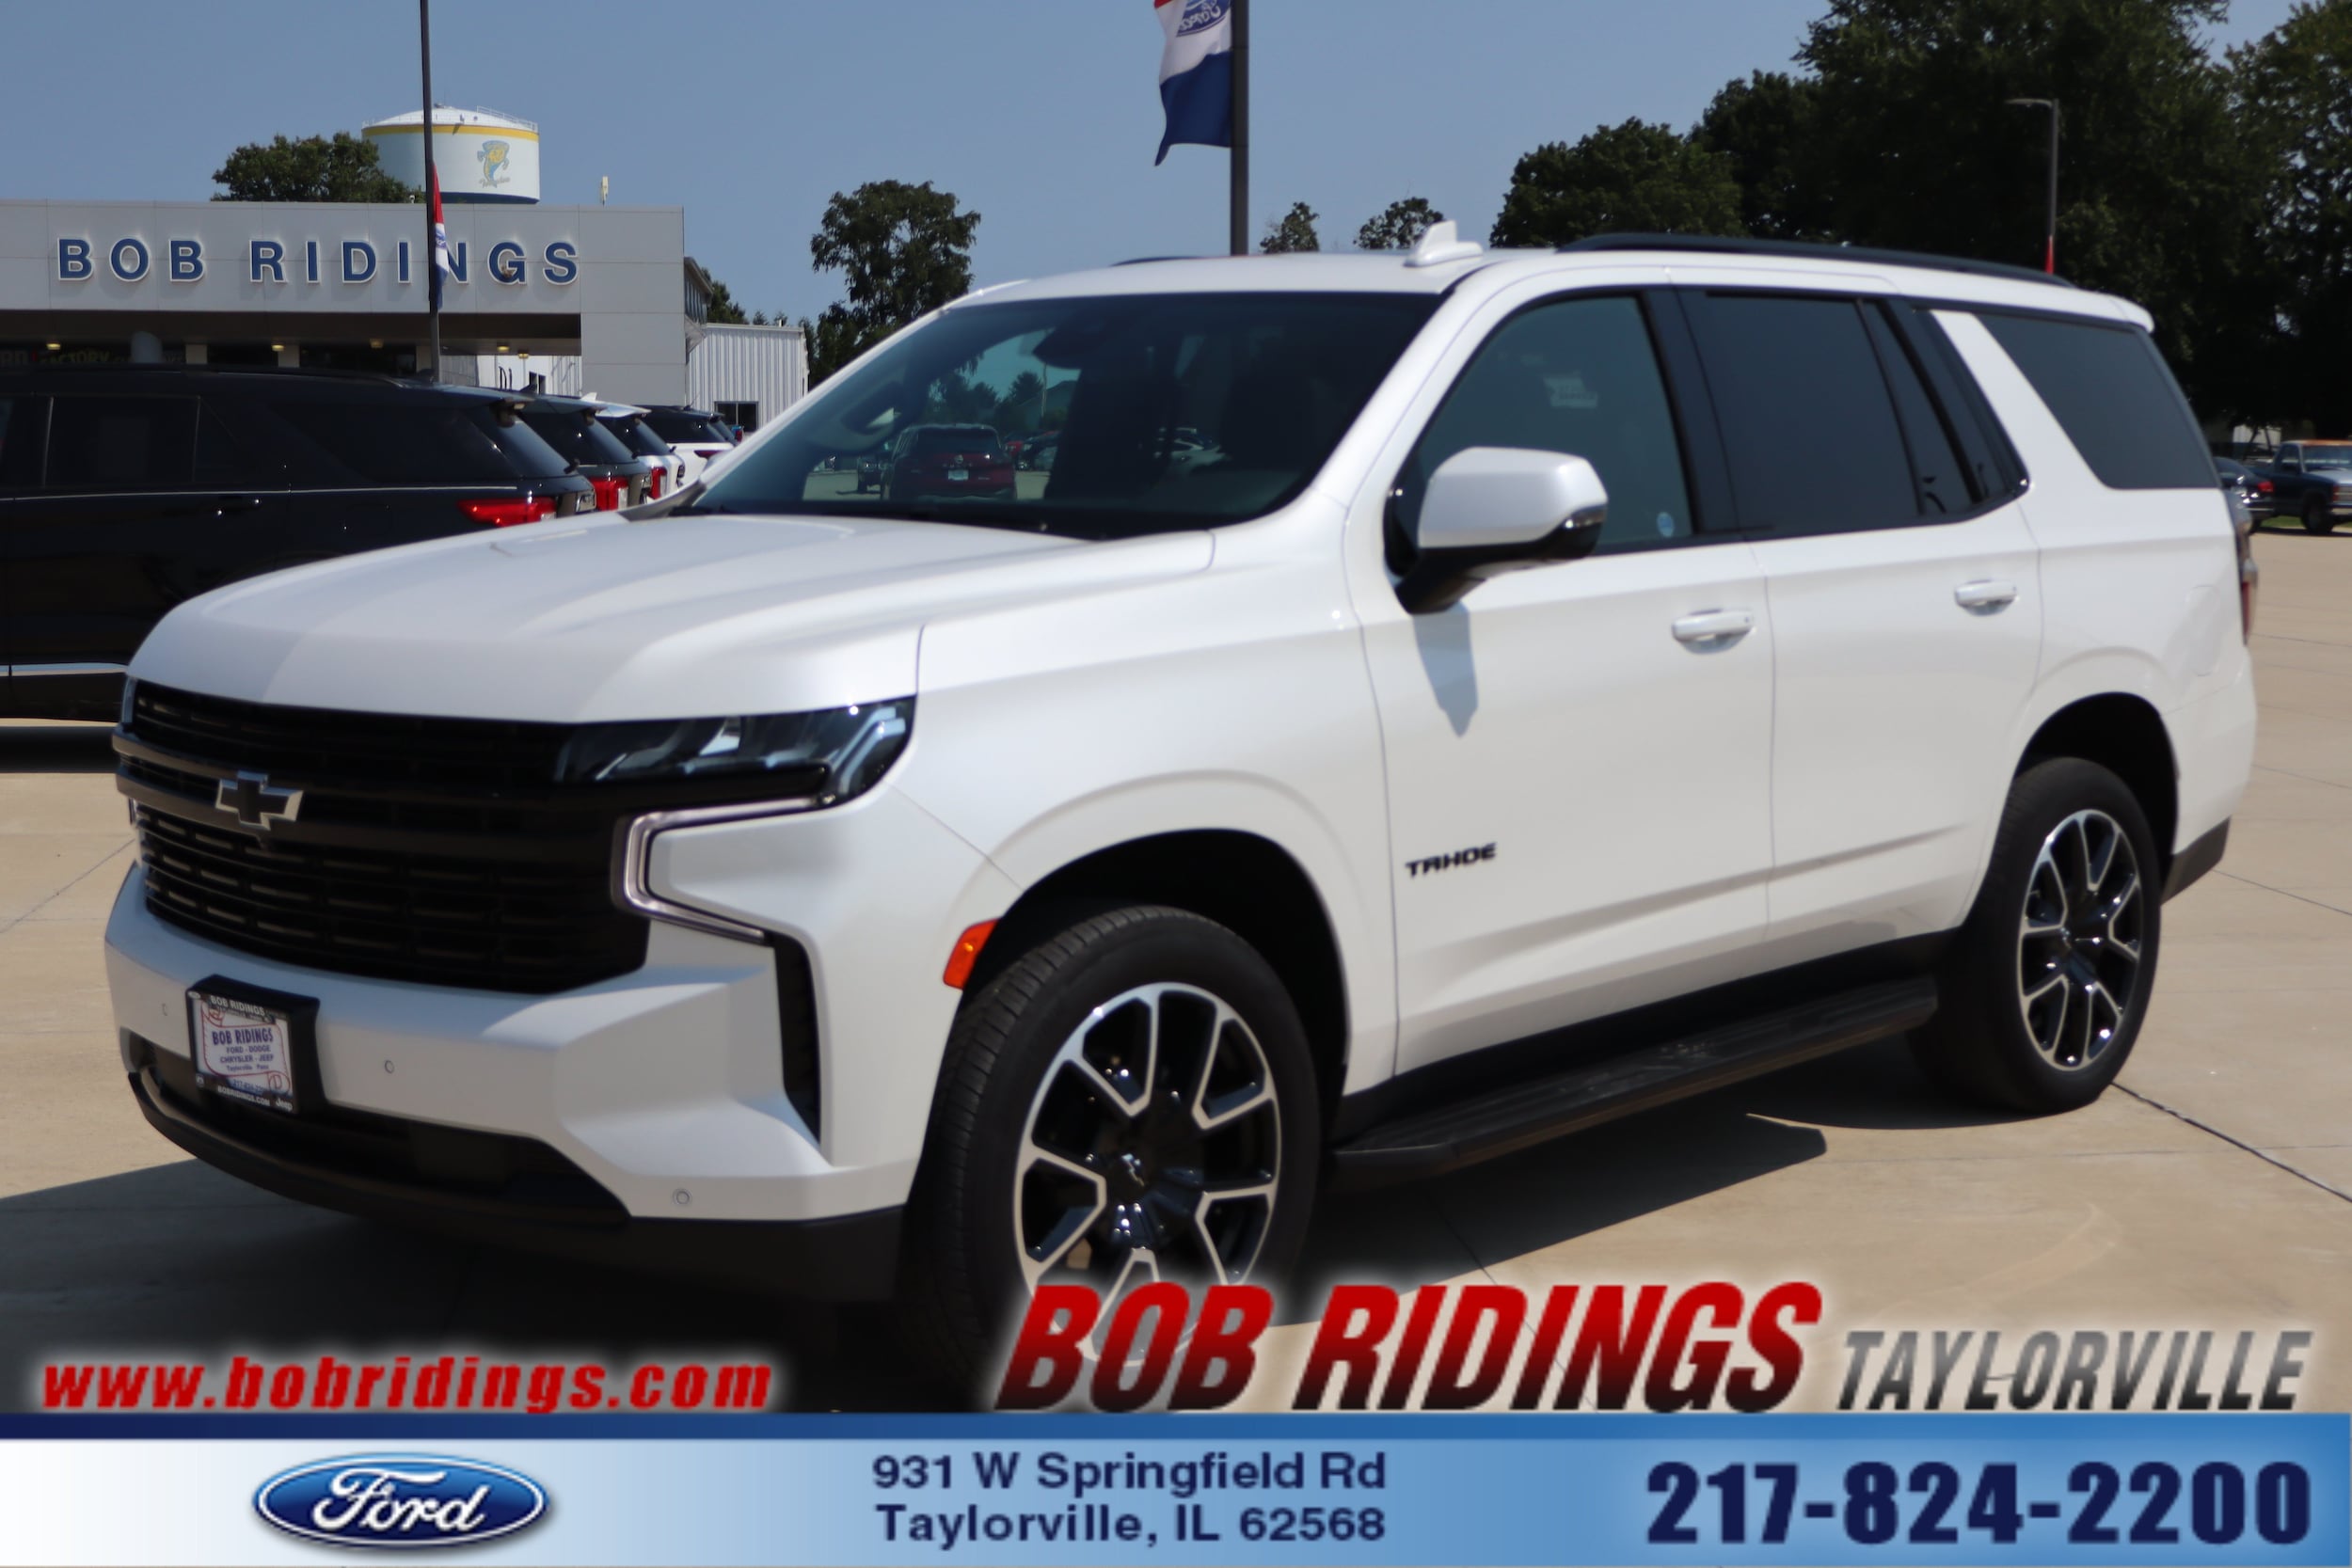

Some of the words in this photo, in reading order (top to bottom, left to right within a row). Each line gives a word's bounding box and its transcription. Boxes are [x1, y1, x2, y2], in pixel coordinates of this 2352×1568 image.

[57, 237, 205, 282] BOB
[248, 240, 578, 285] RIDINGS
[1405, 842, 1498, 878] TAHOE
[210, 995, 229, 1007] BOB
[230, 999, 265, 1017] RIDINGS
[212, 1030, 232, 1045] BOB
[234, 1027, 274, 1044] RIDINGS
[220, 1054, 254, 1064] CHRYSLER
[258, 1053, 275, 1062] JEEP
[226, 1046, 244, 1054] FORD
